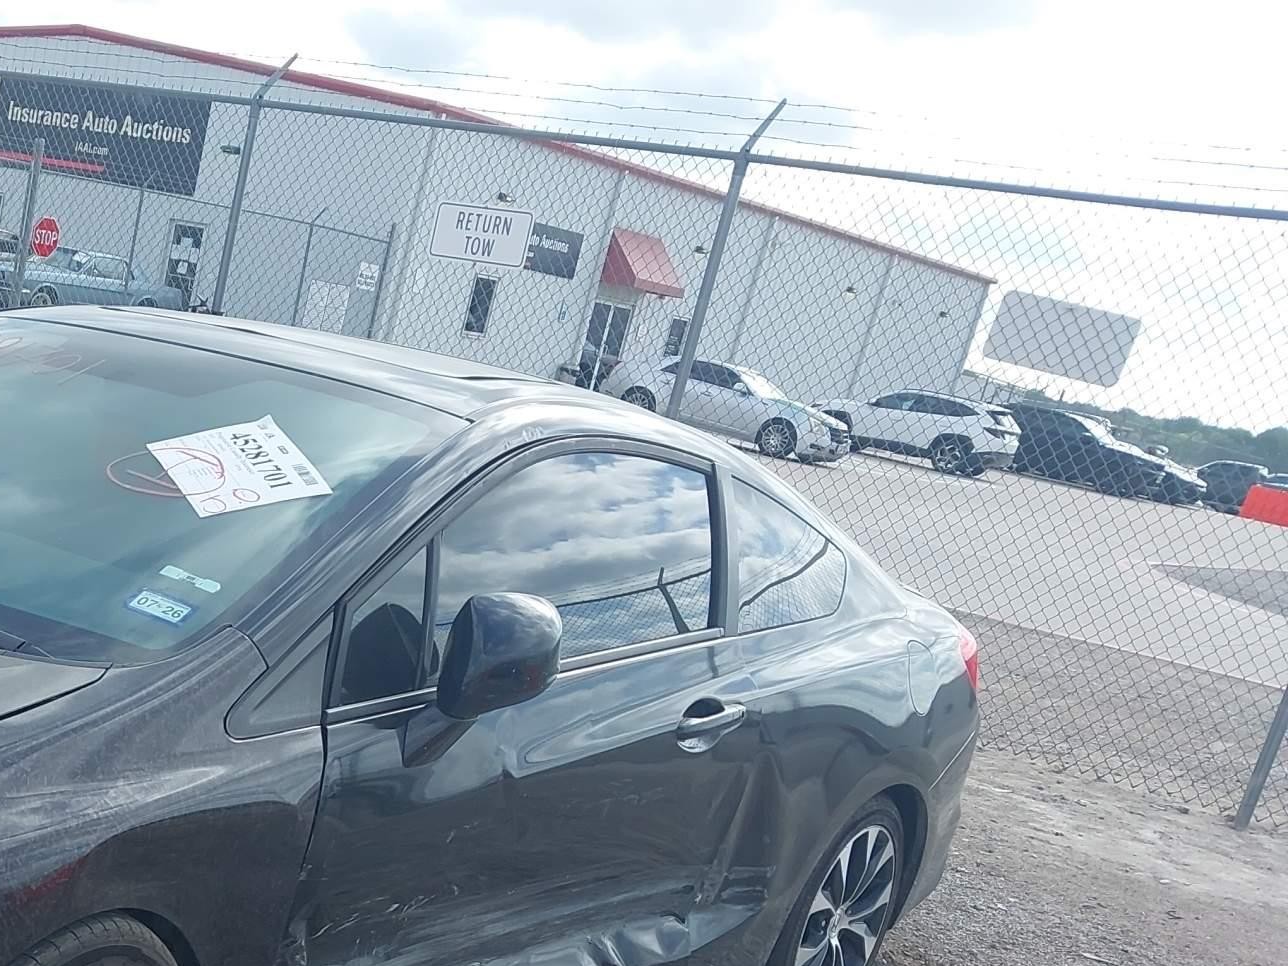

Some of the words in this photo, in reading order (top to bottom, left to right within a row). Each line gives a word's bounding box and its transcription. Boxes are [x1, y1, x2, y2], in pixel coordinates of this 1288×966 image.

[8, 100, 79, 130] Insurance
[82, 110, 118, 134] Auto
[120, 115, 192, 144] Auctions
[456, 211, 513, 236] RETURN
[34, 230, 58, 246] STOP
[464, 235, 495, 257] TOW
[529, 233, 540, 246] uto
[540, 234, 570, 254] Auctions
[230, 433, 293, 489] 45281701
[137, 596, 184, 619] 07-26
